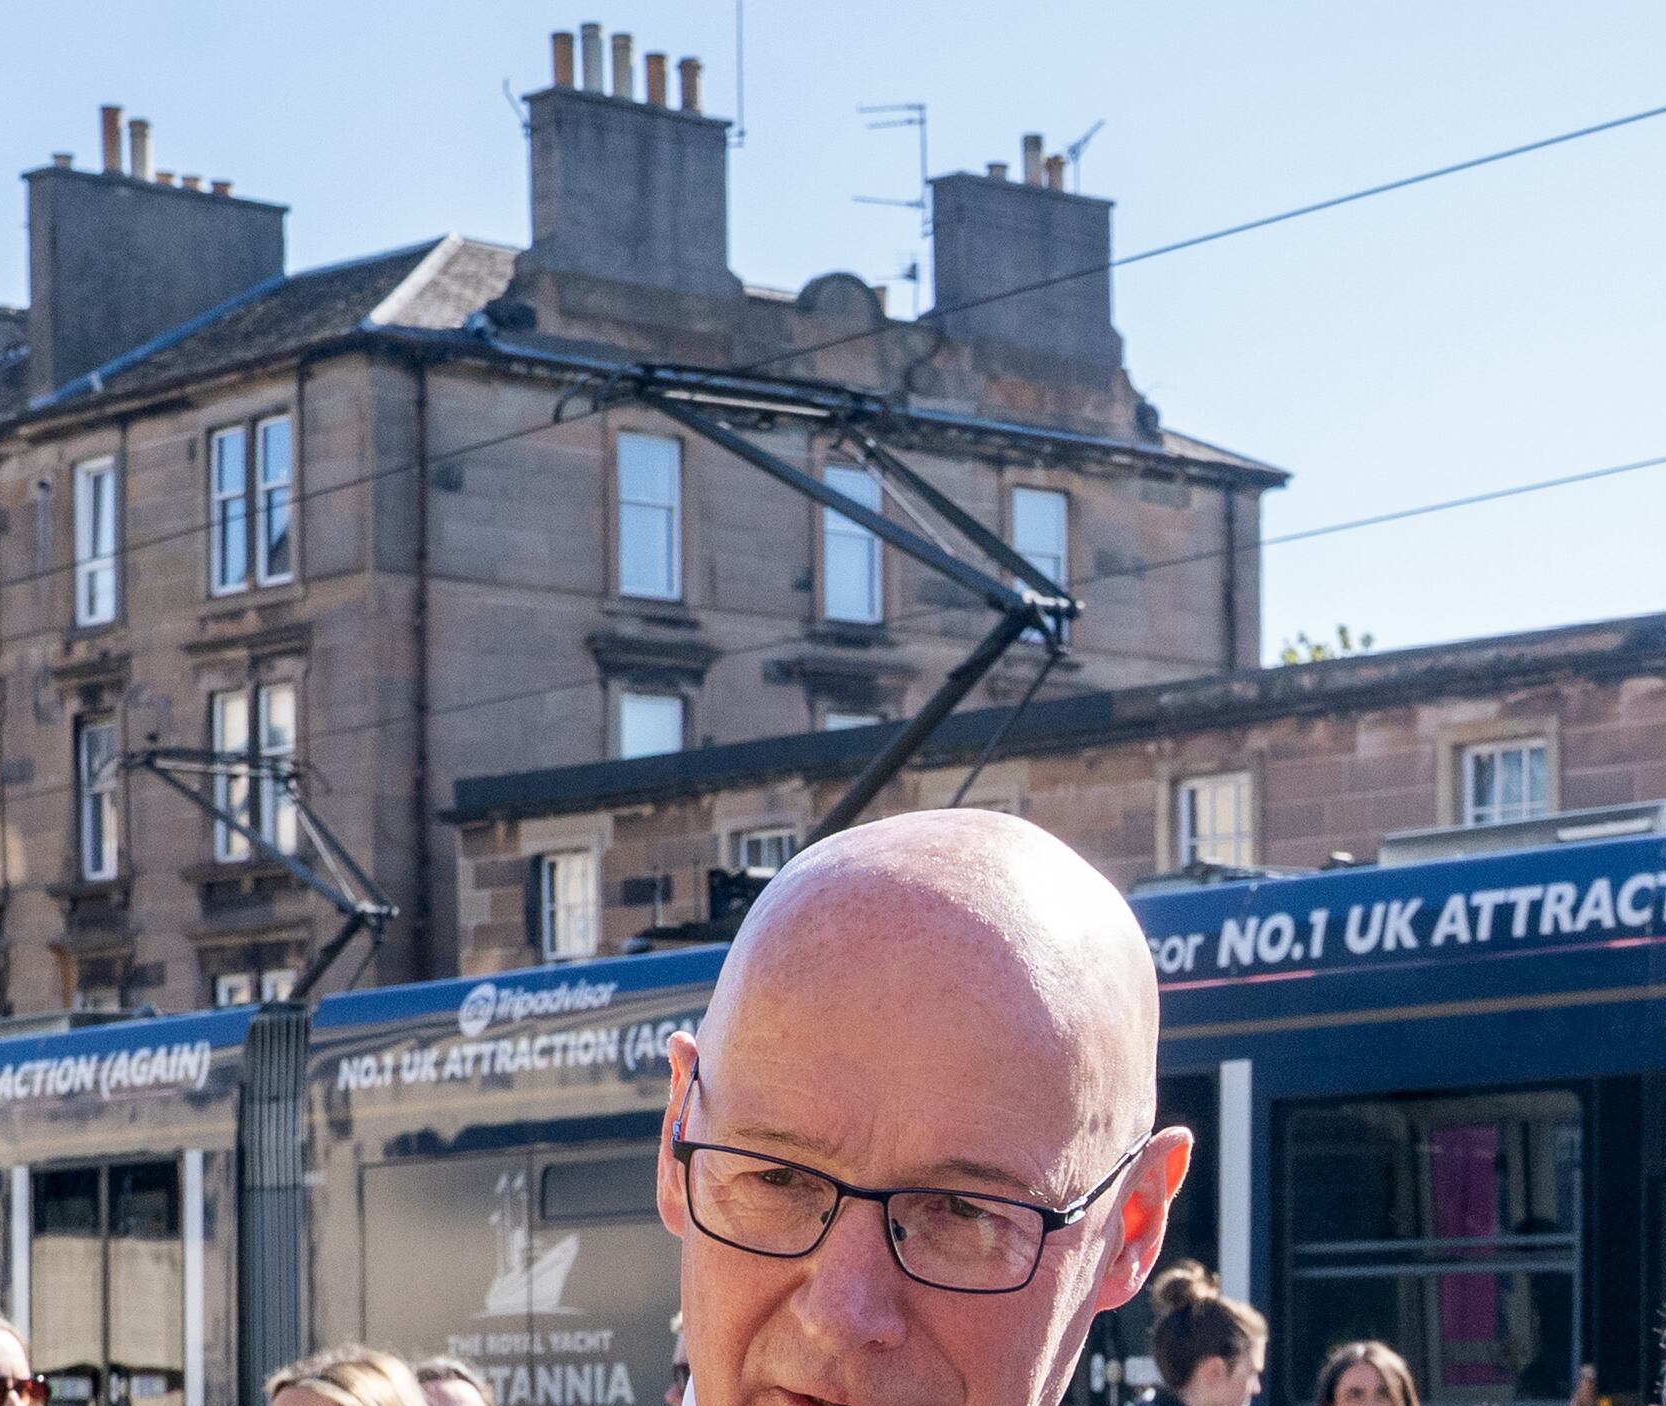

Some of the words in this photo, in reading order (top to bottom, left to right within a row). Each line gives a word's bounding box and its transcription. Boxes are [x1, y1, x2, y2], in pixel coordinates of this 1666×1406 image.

[1216, 908, 1329, 969] NO.1
[1344, 898, 1425, 955] UK
[496, 980, 618, 1022] Tripadvisor
[100, 1041, 211, 1100] (AGAIN)
[336, 1054, 394, 1091] NO.1
[400, 1050, 443, 1082] UK
[442, 1027, 620, 1080] ATTRACTION
[549, 1329, 614, 1353] YACHT
